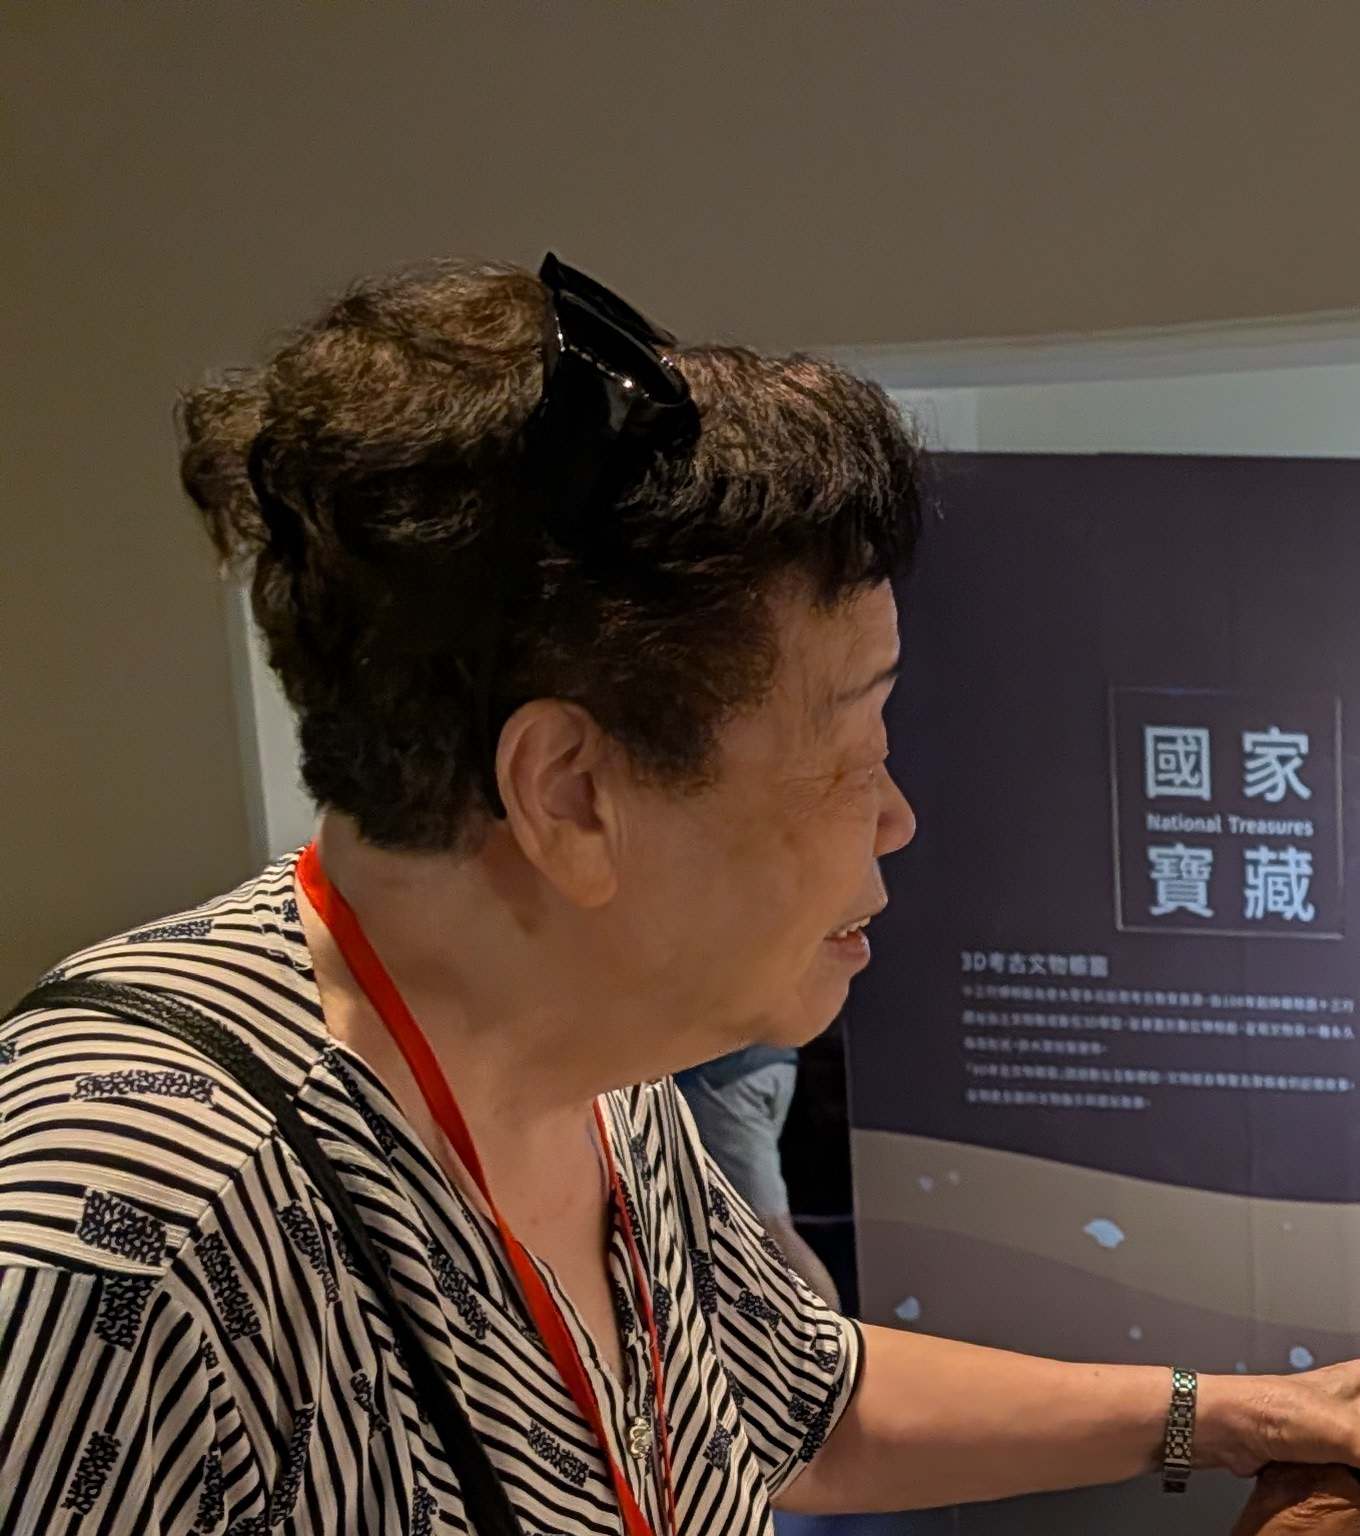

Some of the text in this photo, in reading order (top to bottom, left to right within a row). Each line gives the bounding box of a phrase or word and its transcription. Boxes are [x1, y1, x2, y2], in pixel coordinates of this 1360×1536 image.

[1144, 726, 1312, 802] 國家
[1146, 813, 1315, 837] National Treasures
[1148, 842, 1315, 922] 寶藏
